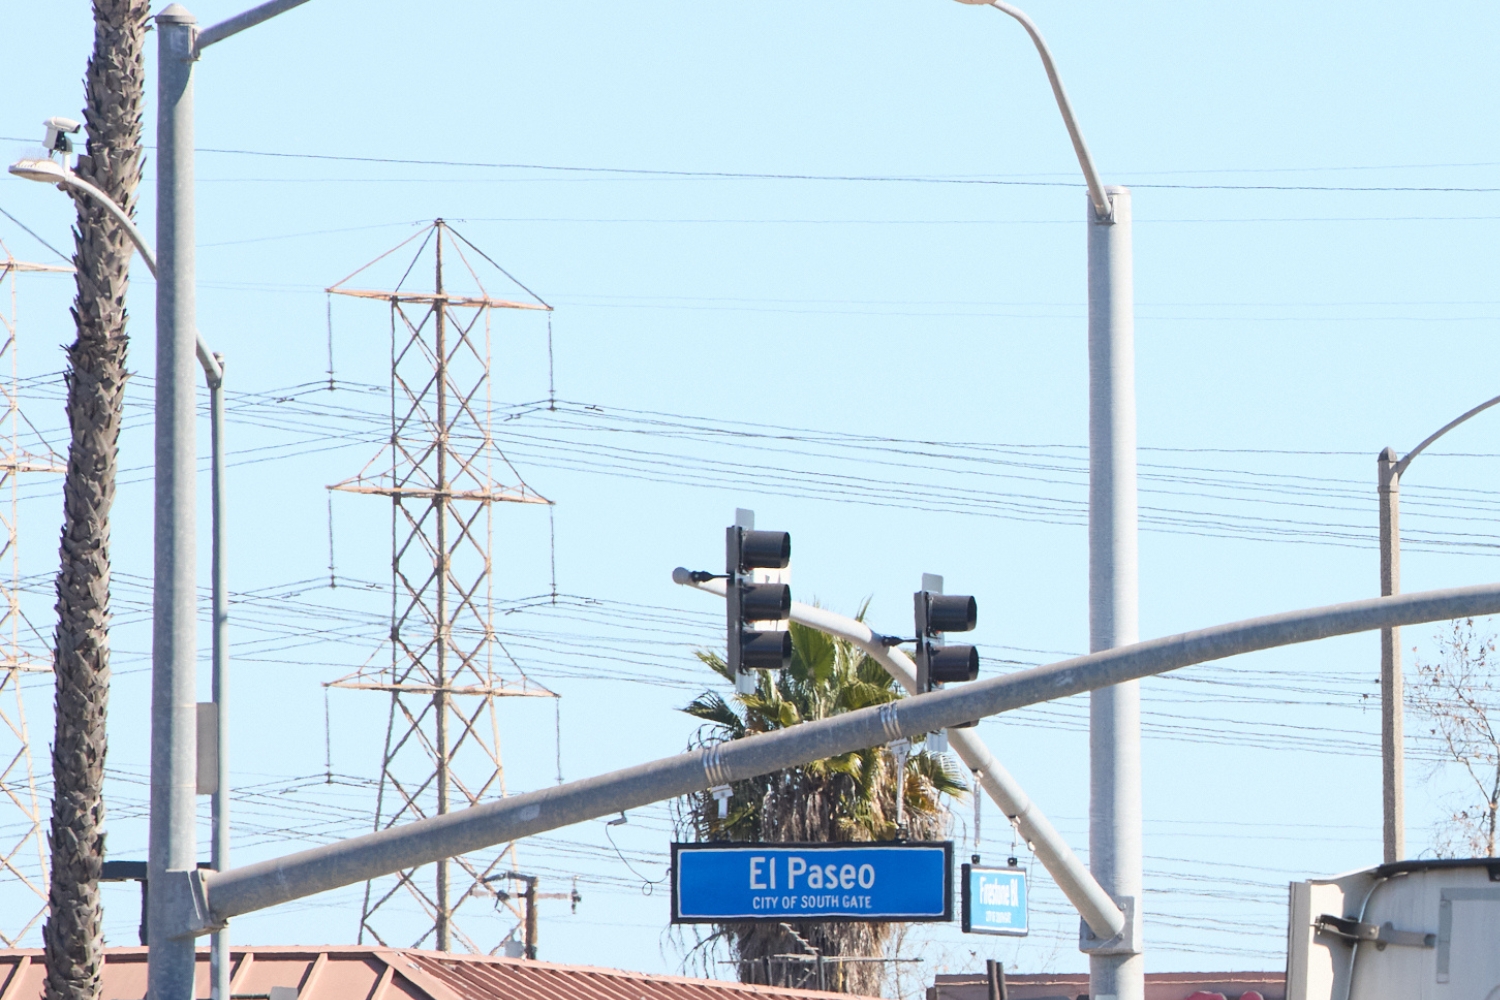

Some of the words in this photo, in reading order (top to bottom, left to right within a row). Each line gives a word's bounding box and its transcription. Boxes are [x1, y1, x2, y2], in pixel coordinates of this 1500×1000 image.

[750, 857, 776, 890] El
[787, 856, 875, 890] Paseo
[753, 896, 778, 909] CITY
[782, 896, 797, 909] OF
[801, 896, 839, 909] SOUTH
[842, 895, 872, 909] GATE
